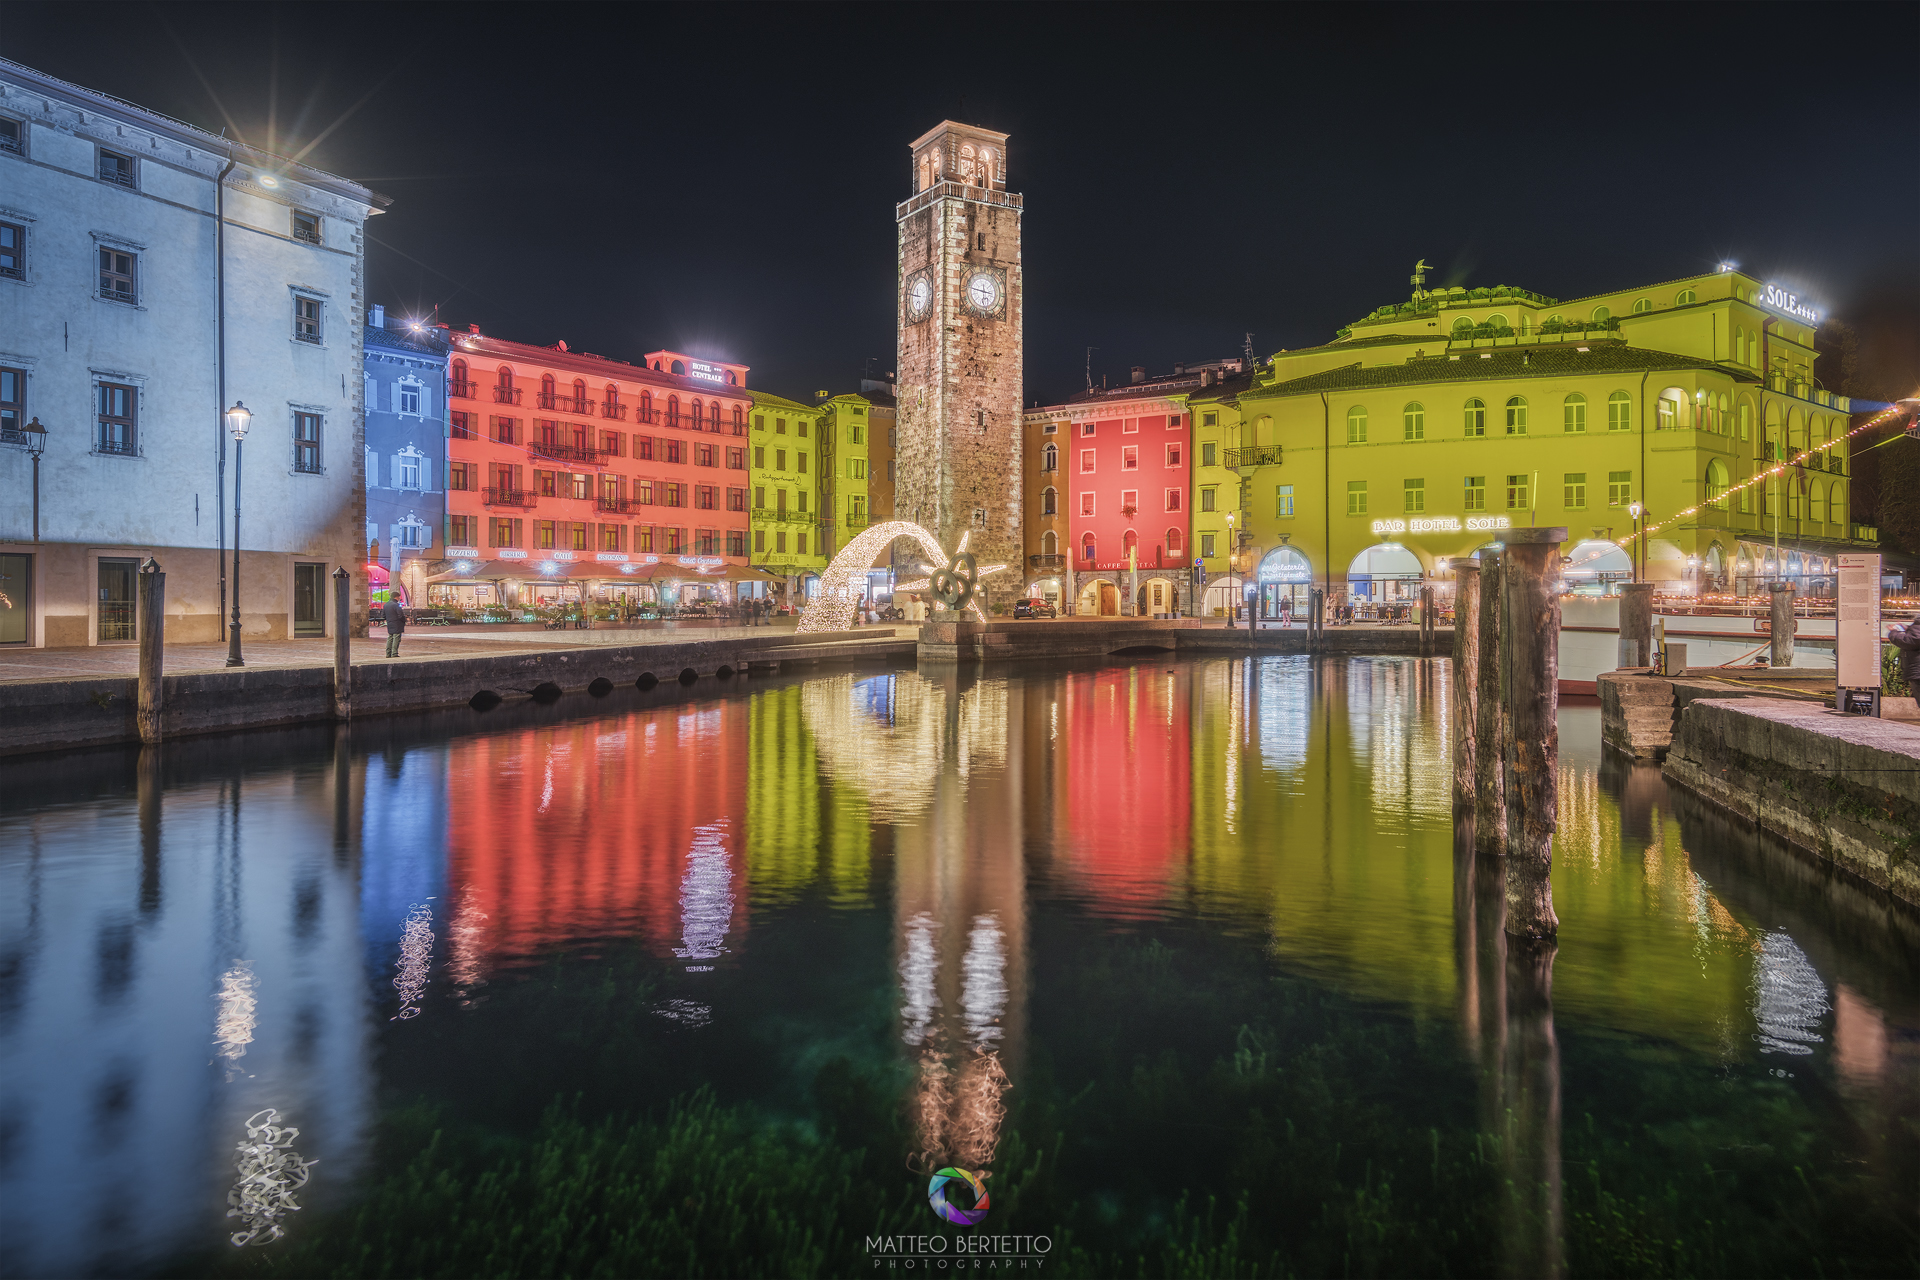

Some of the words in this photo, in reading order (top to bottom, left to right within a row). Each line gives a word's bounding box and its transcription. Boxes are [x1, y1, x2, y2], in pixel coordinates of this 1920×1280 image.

[1767, 284, 1797, 315] SOLE
[692, 363, 711, 372] HOTEL
[692, 371, 722, 382] CENTRALE
[1374, 521, 1404, 532] BAR
[1411, 519, 1461, 531] HOTEL
[1467, 517, 1508, 530] SOLE
[757, 555, 800, 564] BRRERIA
[1871, 565, 1879, 637] storico-artistici
[1871, 640, 1879, 676] Itinerari
